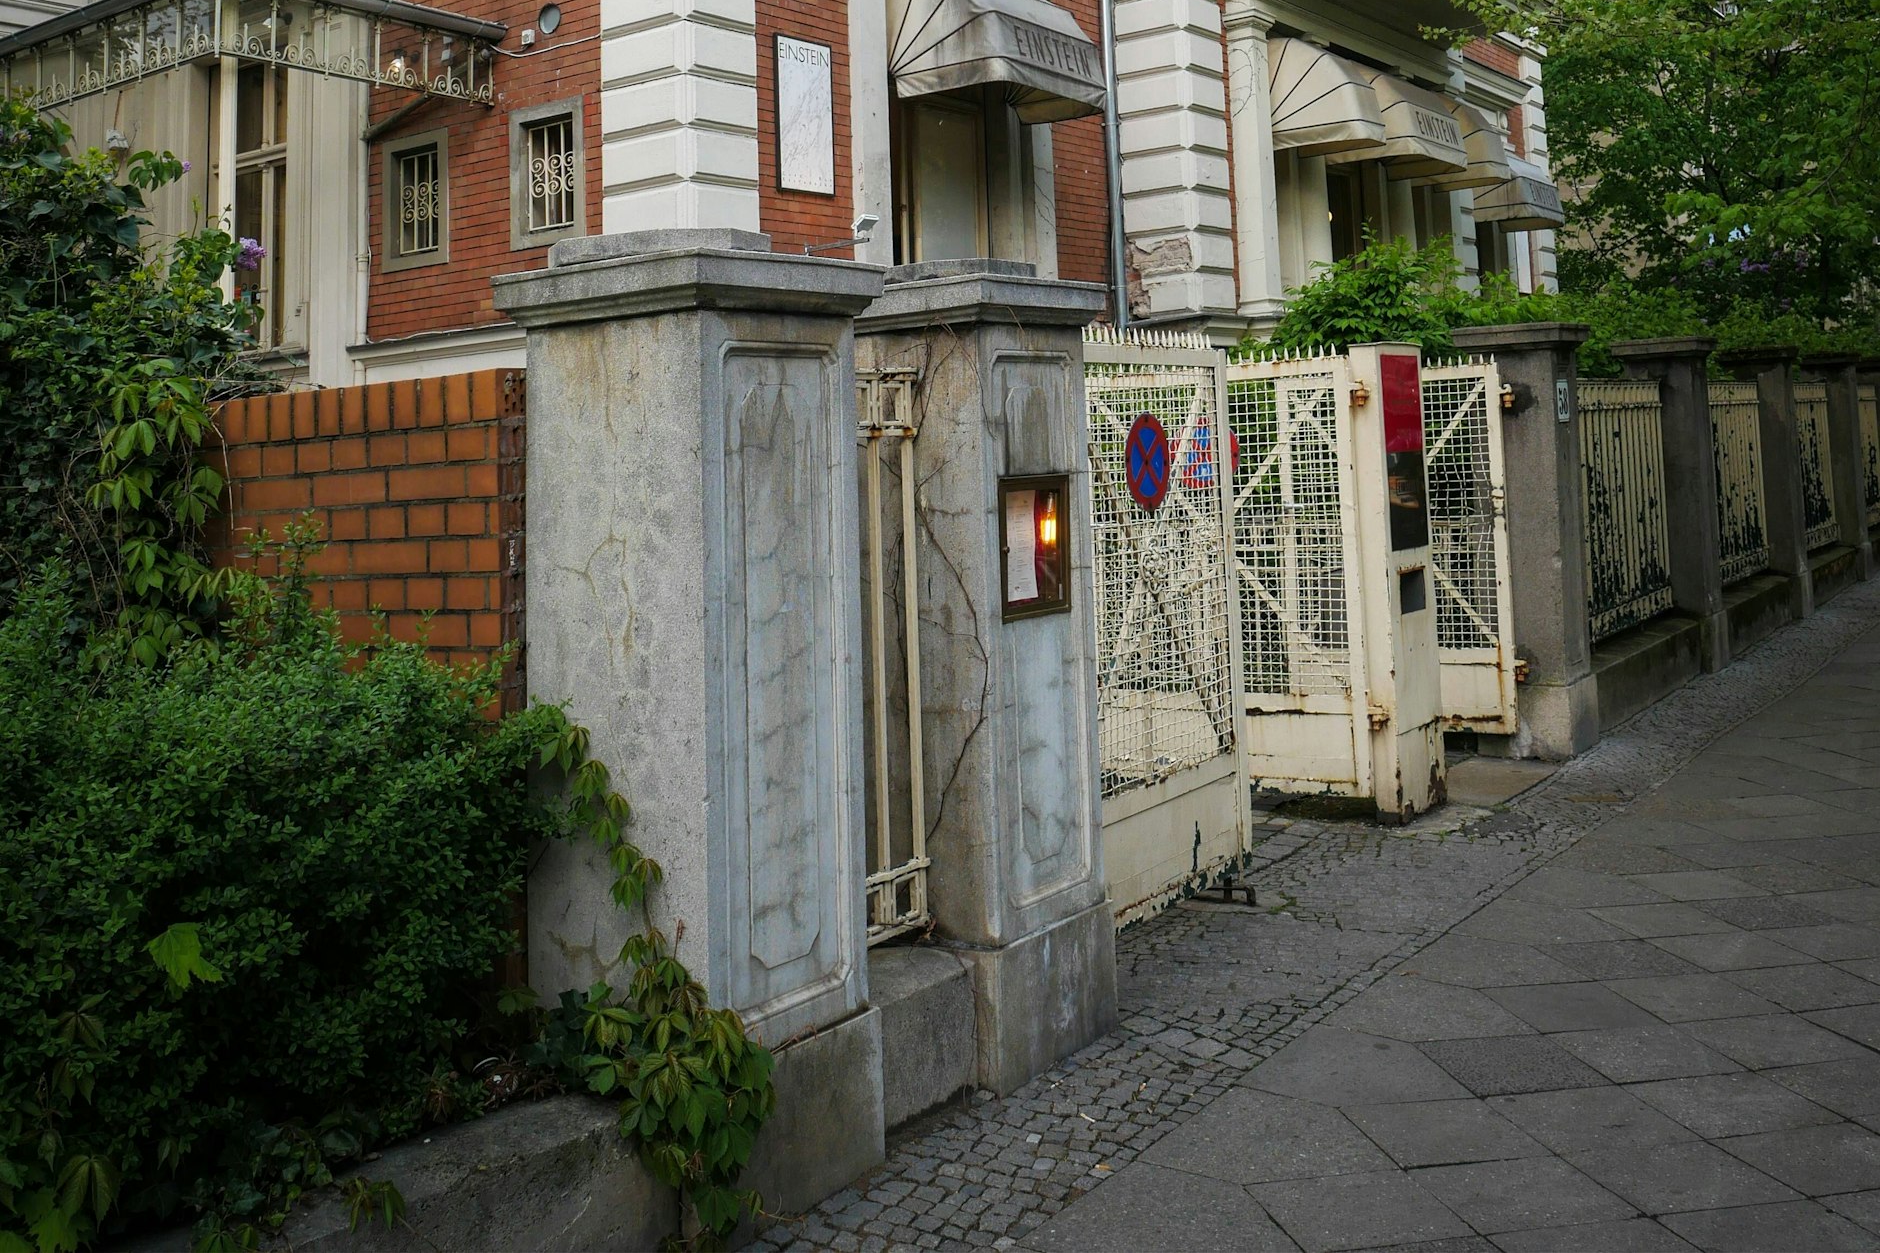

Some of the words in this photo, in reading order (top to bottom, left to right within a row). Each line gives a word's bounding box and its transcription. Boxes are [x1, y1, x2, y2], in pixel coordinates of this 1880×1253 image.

[779, 42, 830, 68] EINSTEIN
[1014, 25, 1092, 78] EINSTEIN
[1415, 111, 1459, 145] EINSTEIN
[1558, 387, 1569, 415] 58
